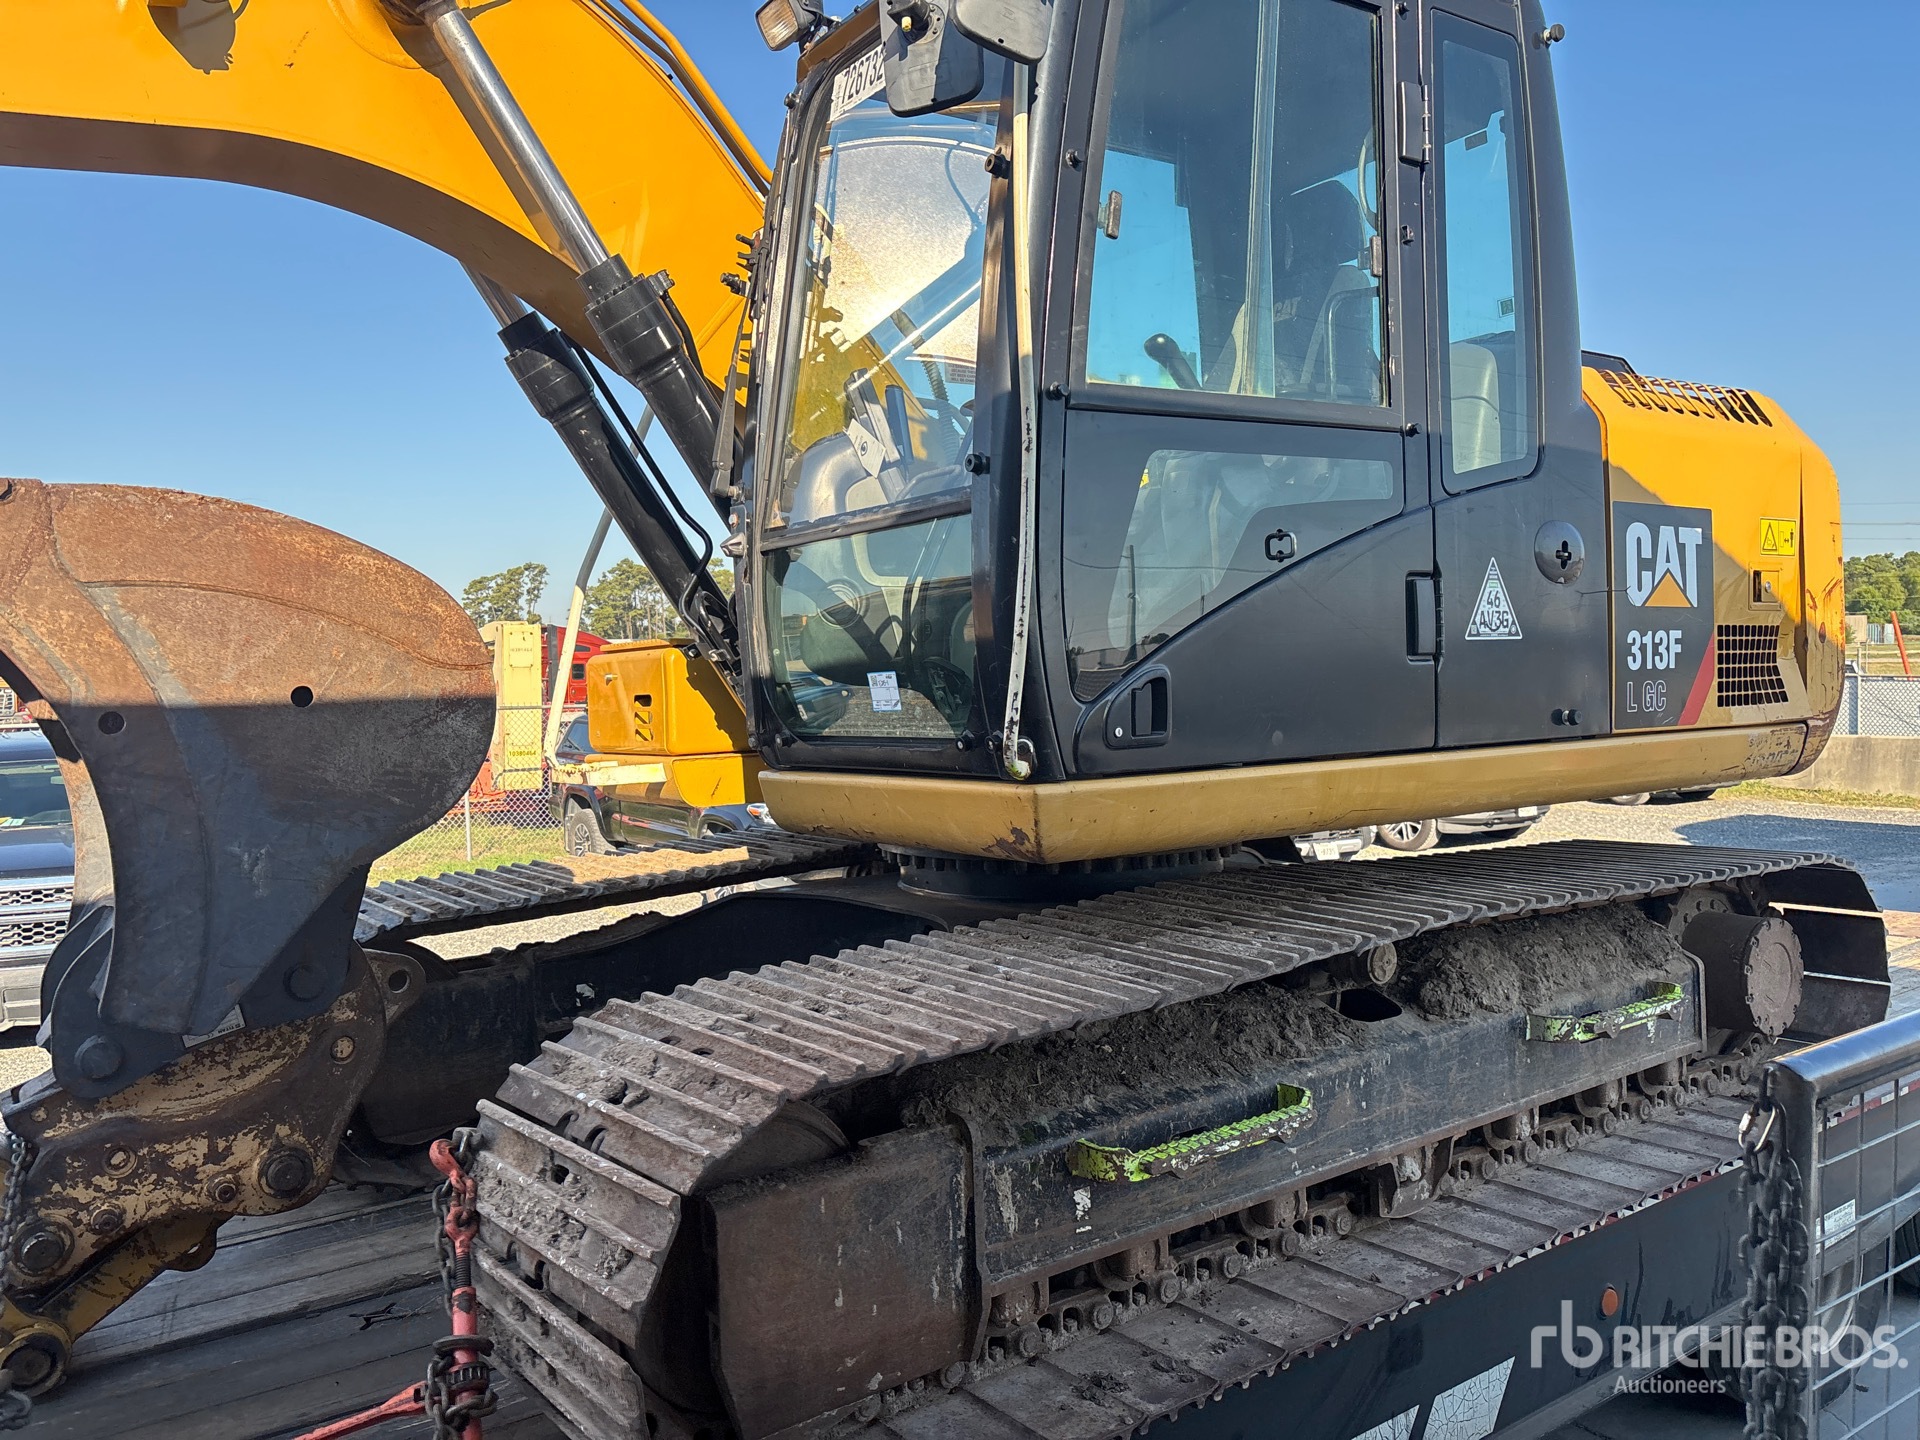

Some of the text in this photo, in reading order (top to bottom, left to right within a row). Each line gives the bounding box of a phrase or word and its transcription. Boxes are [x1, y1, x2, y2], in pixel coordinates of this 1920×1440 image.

[1625, 521, 1703, 608] CAT
[1486, 590, 1501, 609] 46
[1626, 629, 1682, 671] 313F
[1626, 679, 1667, 713] L GC
